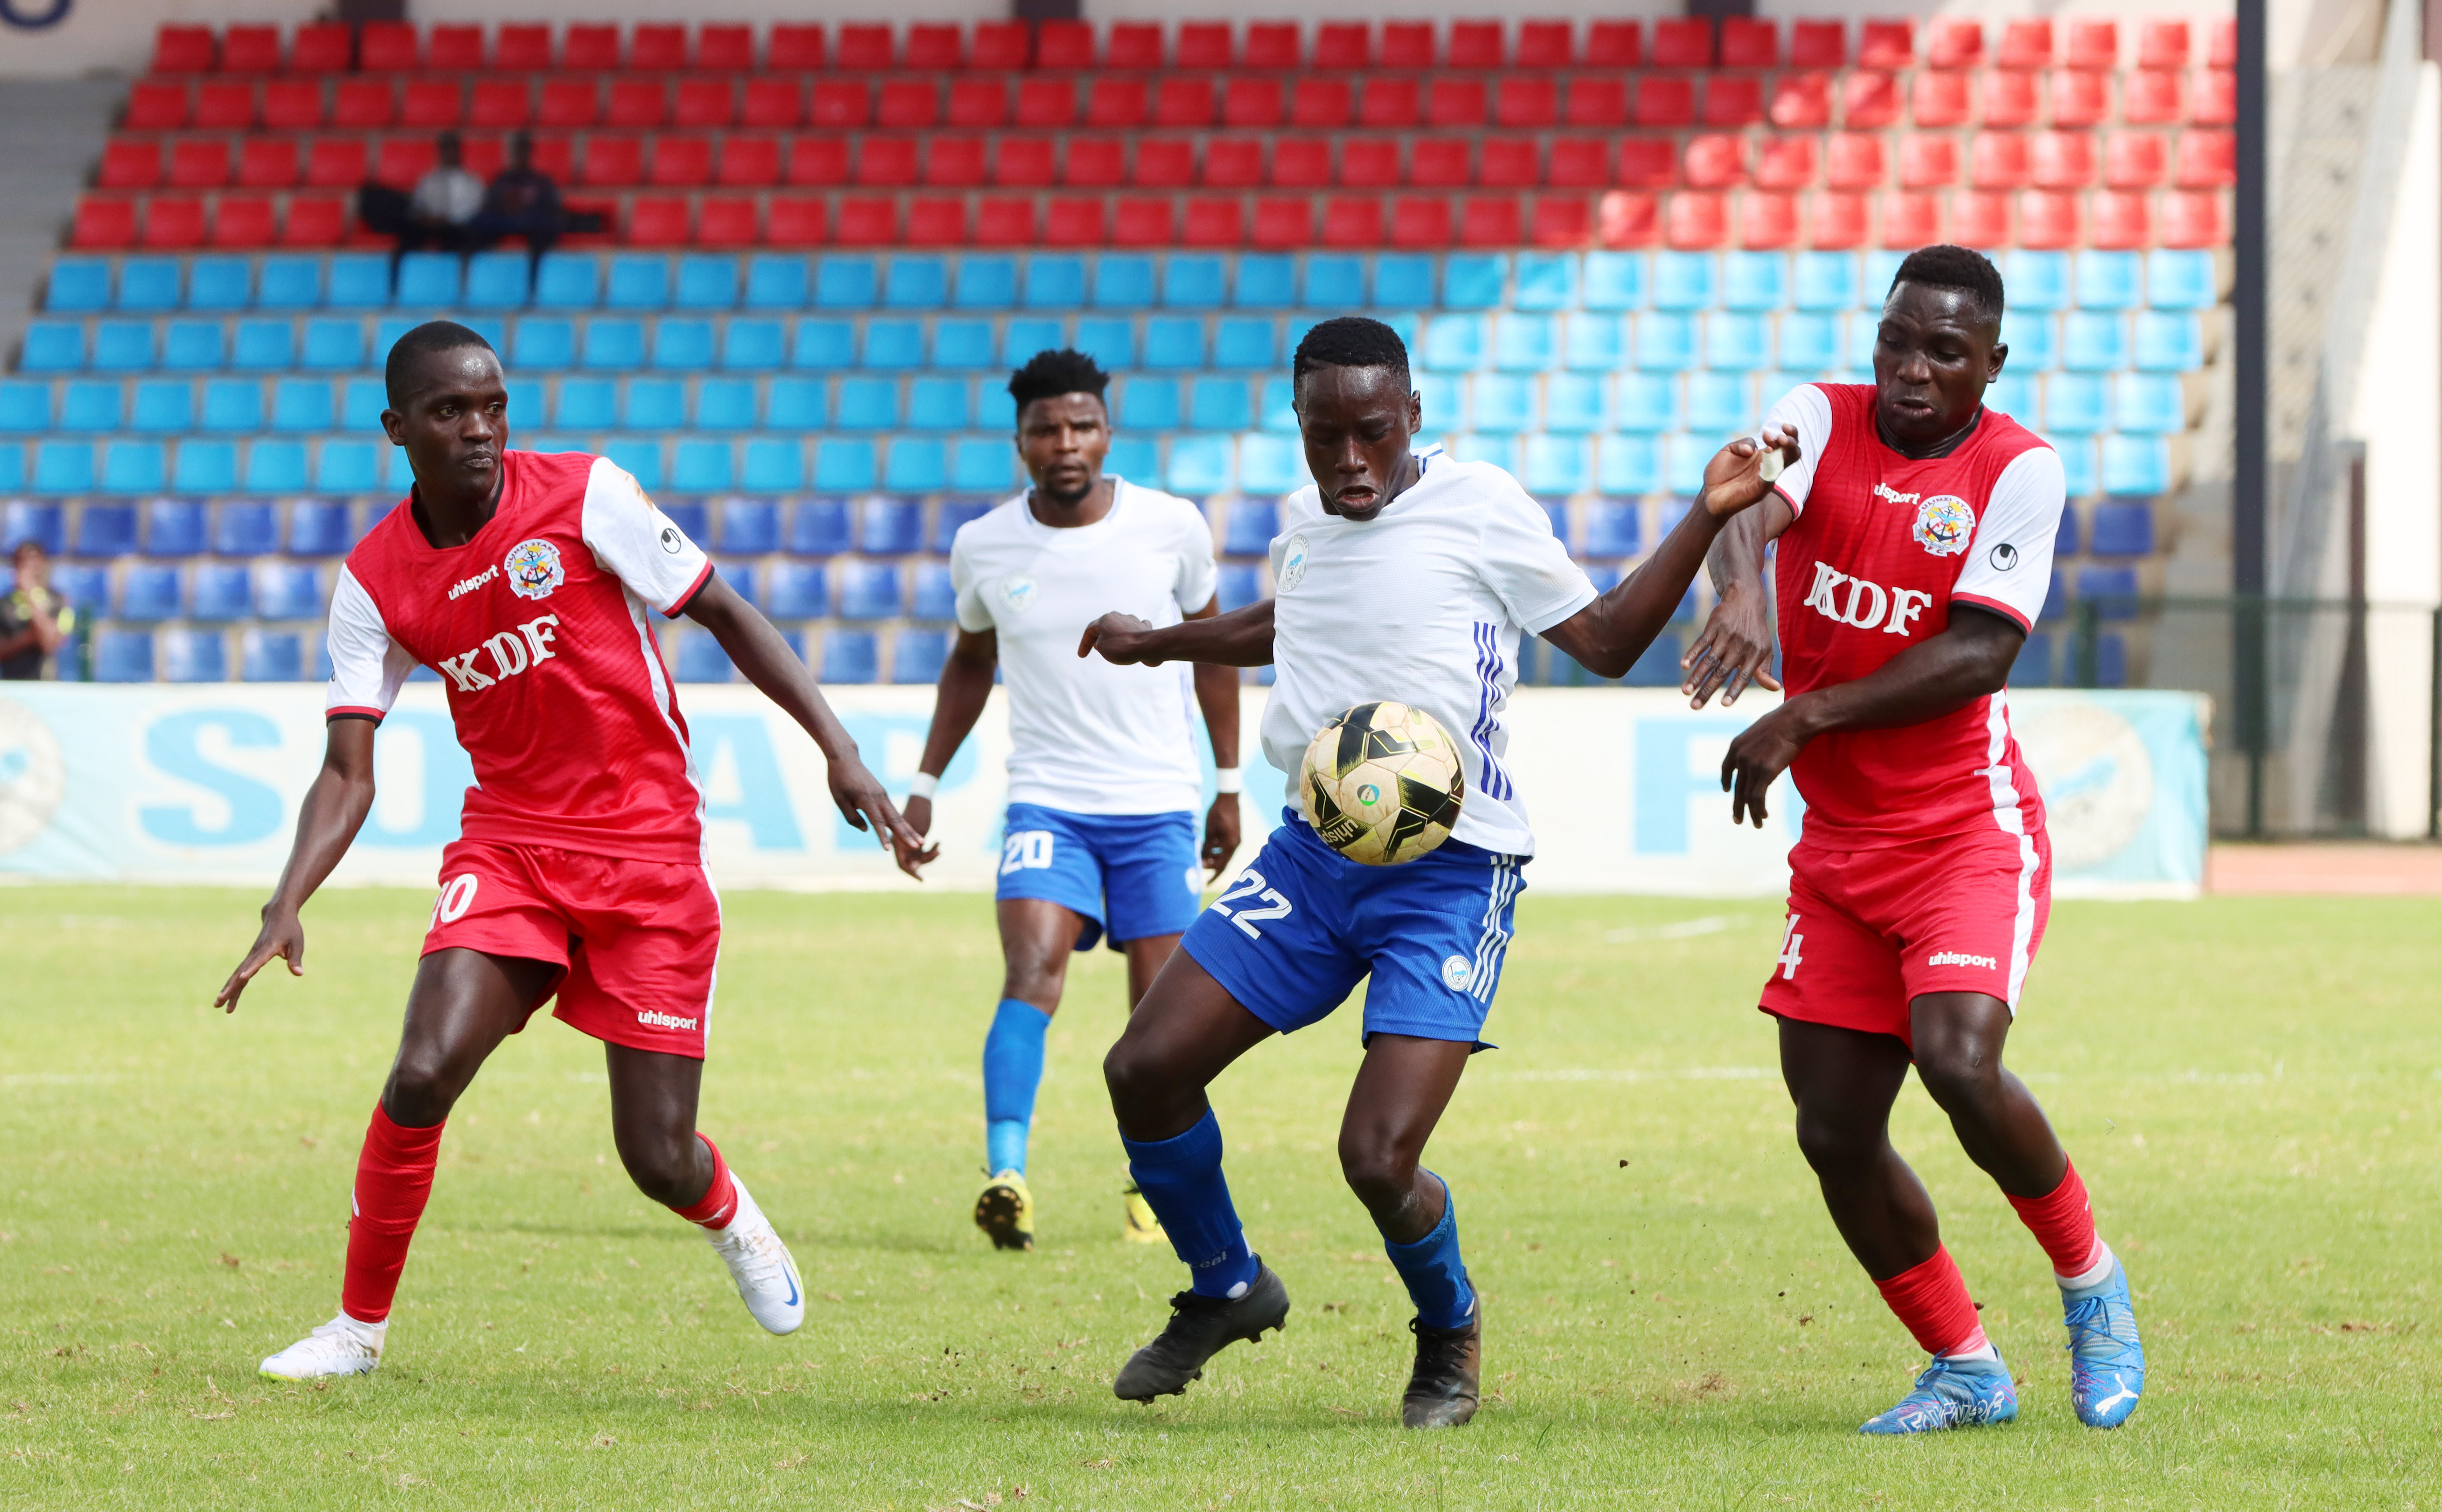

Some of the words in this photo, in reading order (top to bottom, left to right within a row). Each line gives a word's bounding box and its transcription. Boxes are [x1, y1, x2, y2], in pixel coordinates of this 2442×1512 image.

[1921, 497, 1952, 510] ULINZI
[1956, 500, 1973, 524] STARS
[506, 544, 527, 568] ULINZI
[531, 542, 557, 555] STARS
[448, 564, 499, 600] uhlsport
[1803, 560, 1932, 637] KDF
[438, 614, 560, 692] KDF
[1001, 830, 1054, 876] 20
[1209, 868, 1288, 940] 22
[1778, 914, 1804, 980] 4
[1928, 951, 1997, 970] uhlsport
[638, 1010, 697, 1030] uhlsport
